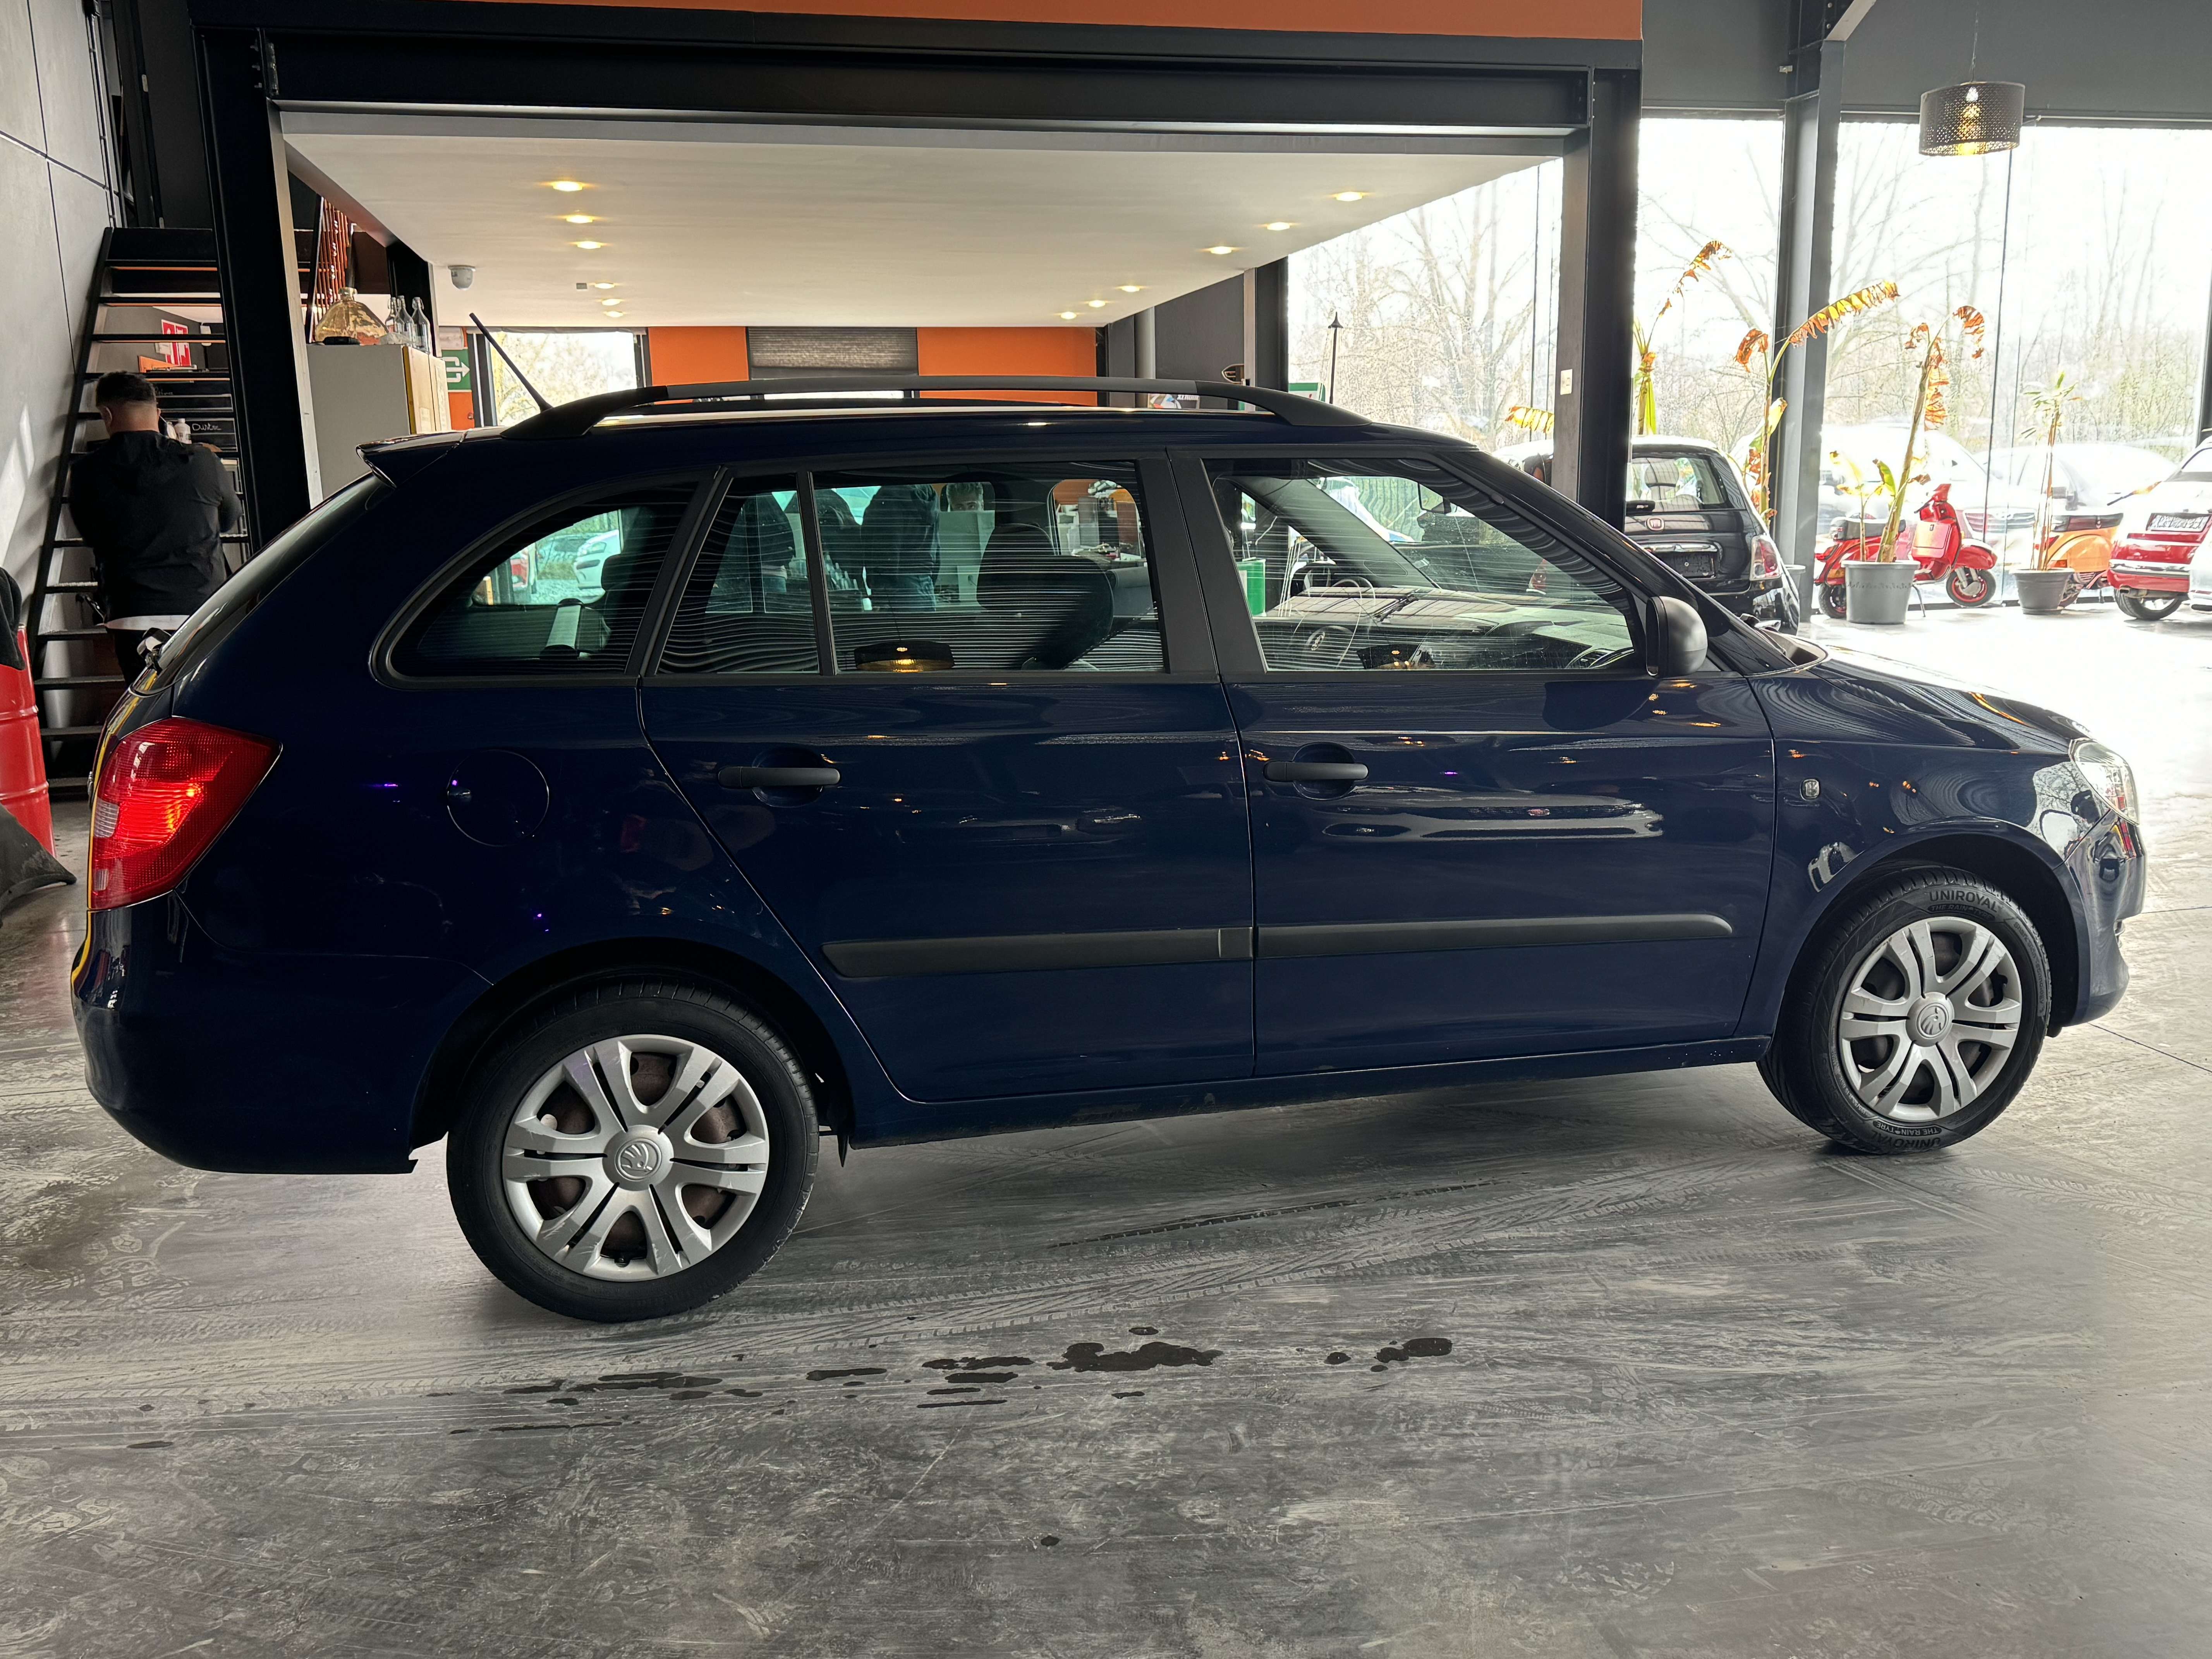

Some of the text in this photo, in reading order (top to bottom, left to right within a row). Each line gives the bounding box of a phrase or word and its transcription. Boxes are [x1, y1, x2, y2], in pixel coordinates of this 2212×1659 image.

[1929, 890, 1997, 912] UNIROYAL
[1876, 1121, 1895, 1133] TYRE
[1871, 1130, 1941, 1148] UNIROYAL
